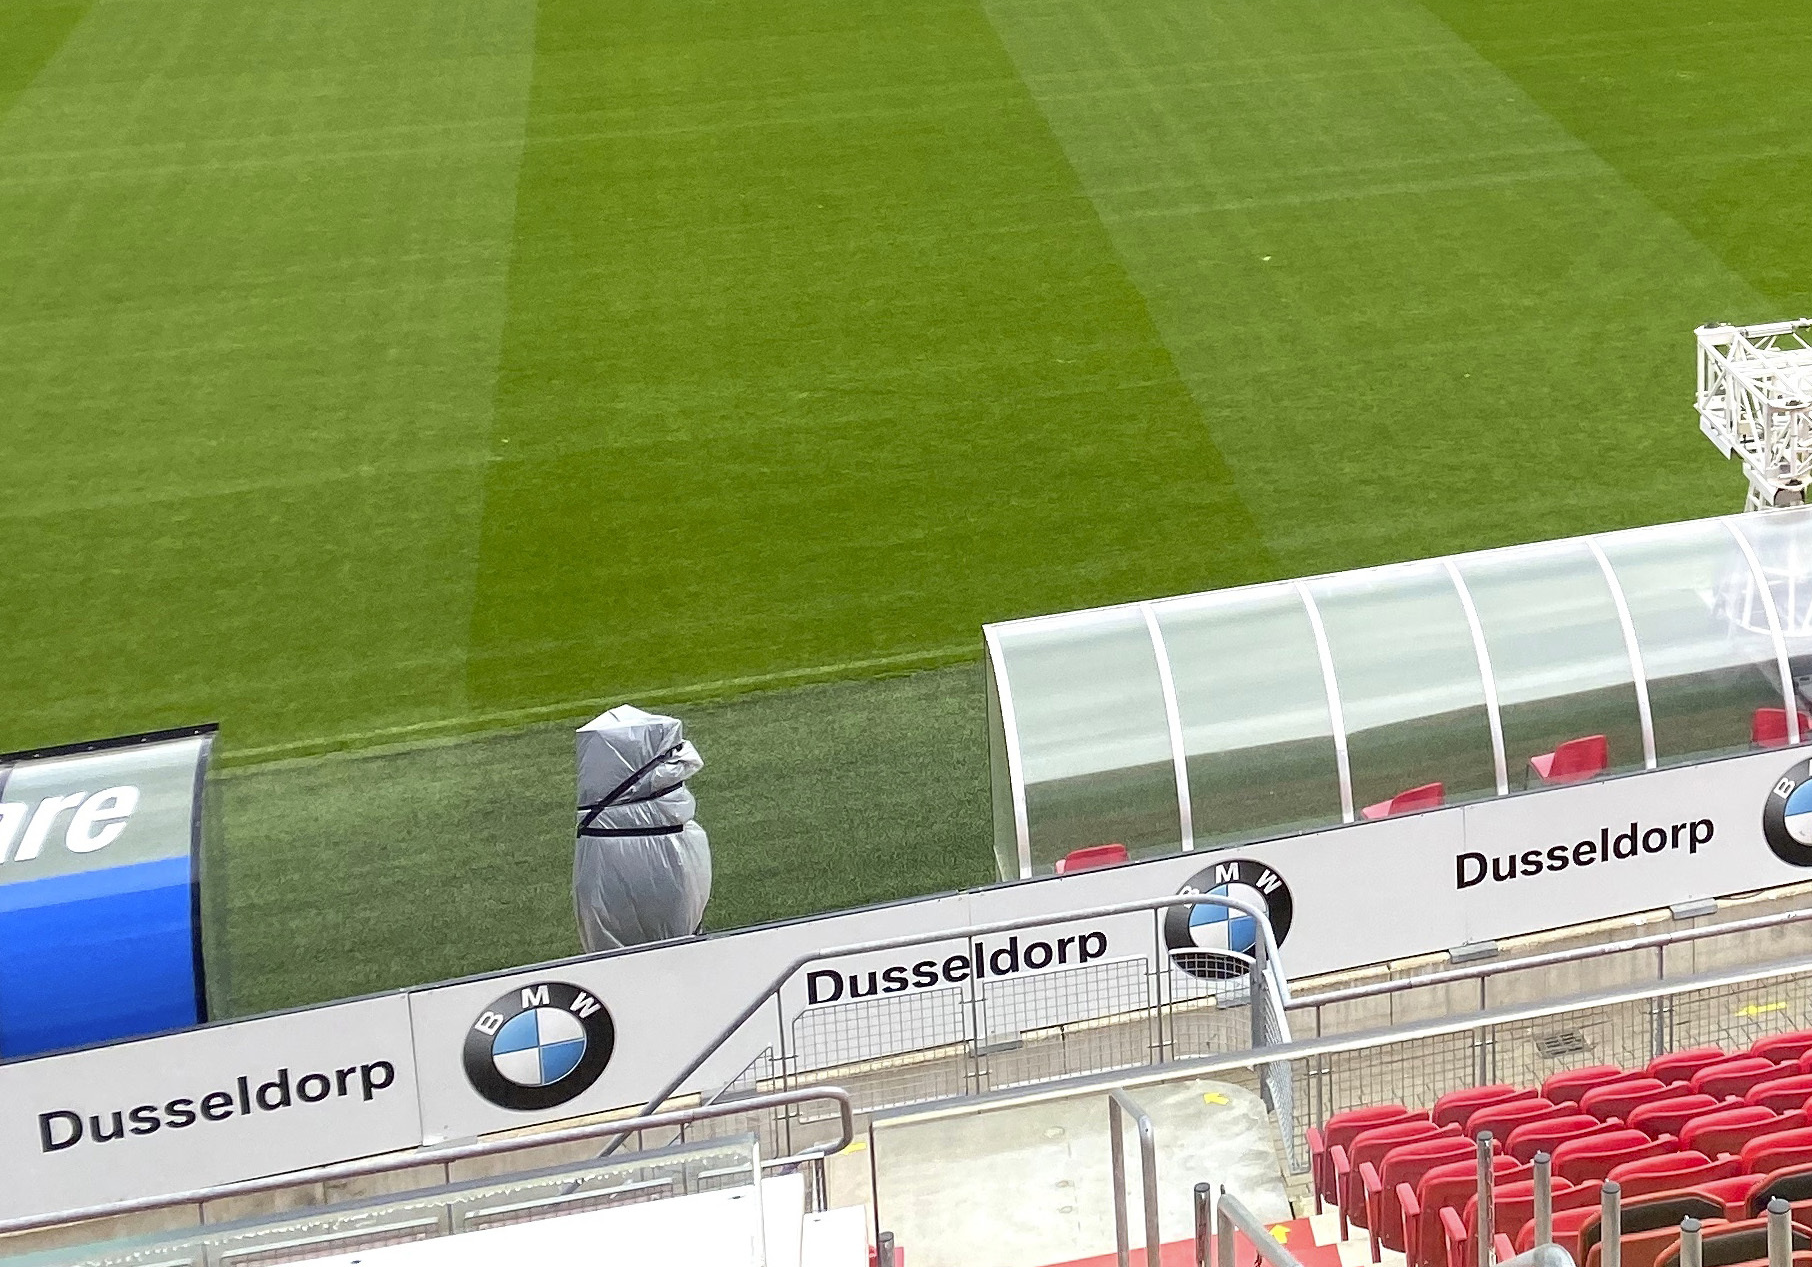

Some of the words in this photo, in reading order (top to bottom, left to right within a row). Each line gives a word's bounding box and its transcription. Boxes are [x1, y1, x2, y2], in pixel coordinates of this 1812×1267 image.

[1456, 818, 1714, 890] Dusseldorp
[806, 931, 1108, 1006] Dusseldorp
[474, 985, 601, 1036] BMW
[38, 1059, 395, 1153] Dusseldorp
